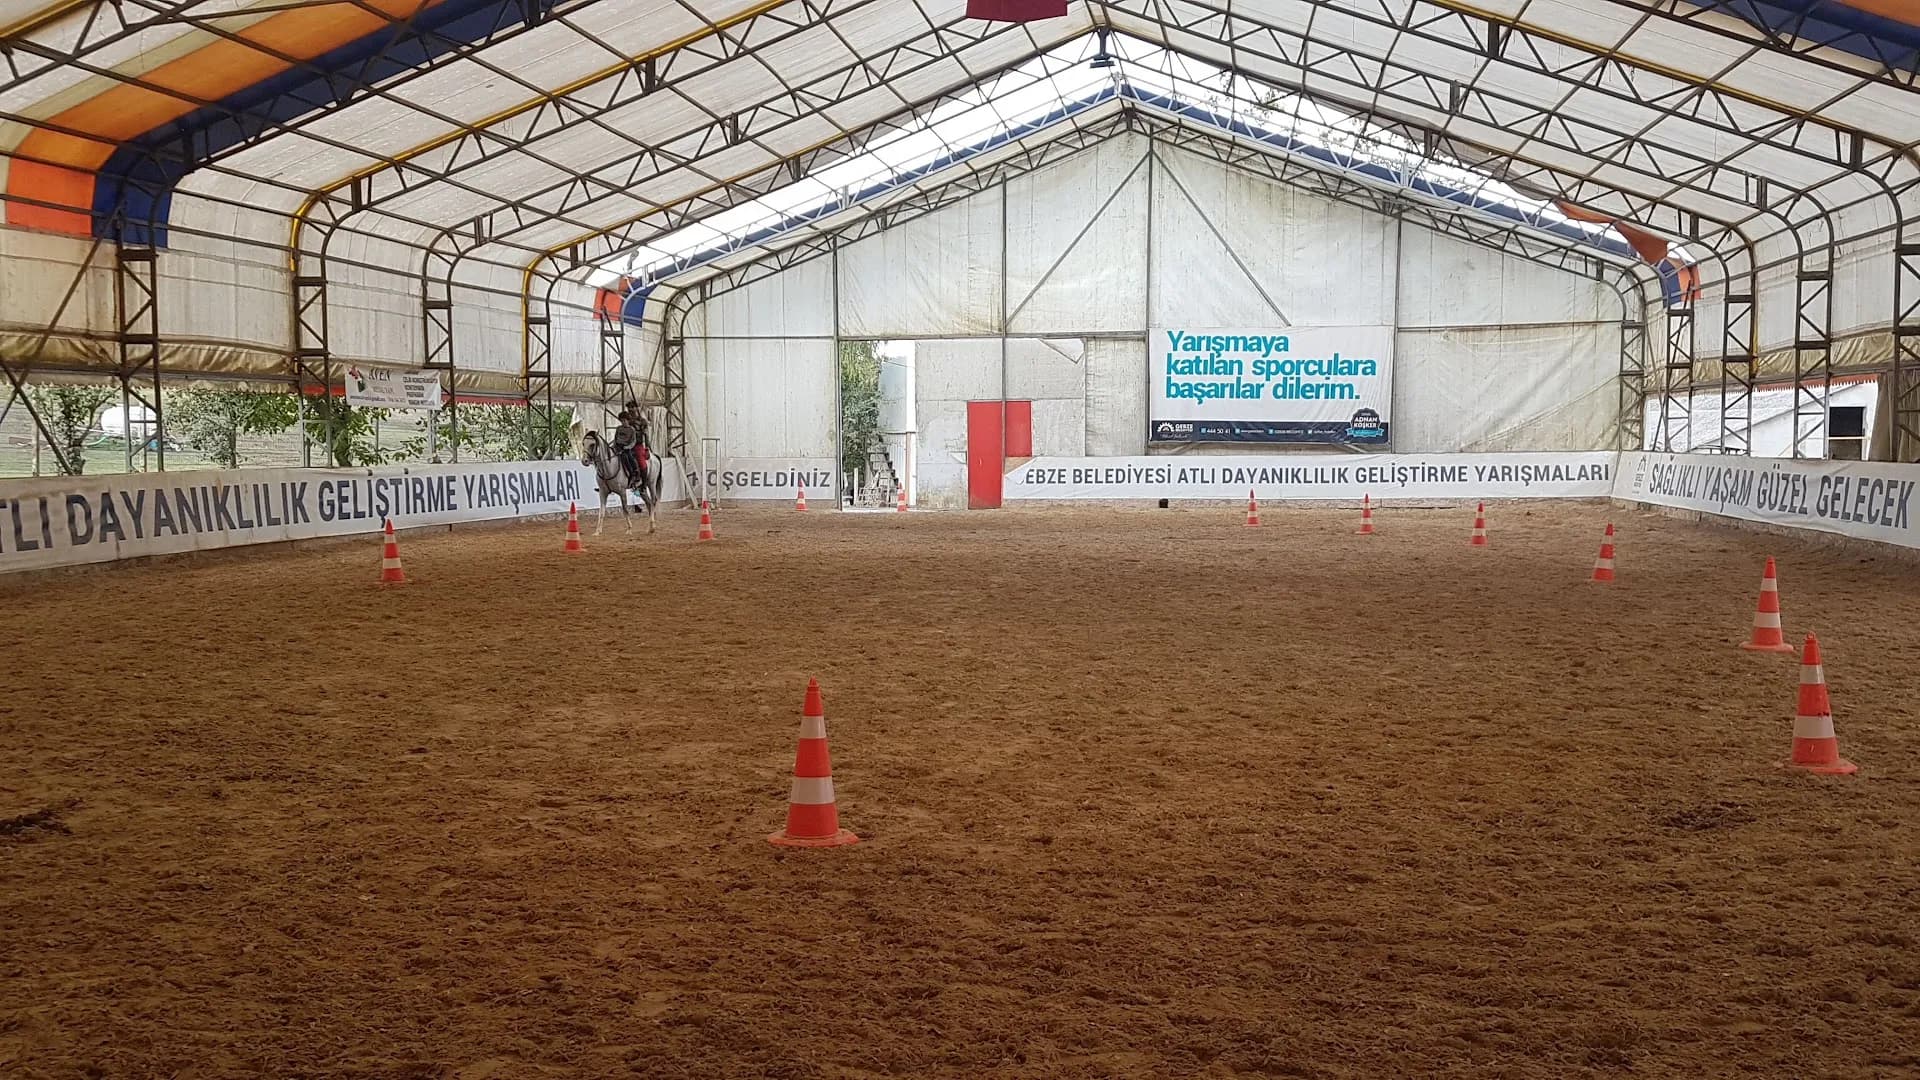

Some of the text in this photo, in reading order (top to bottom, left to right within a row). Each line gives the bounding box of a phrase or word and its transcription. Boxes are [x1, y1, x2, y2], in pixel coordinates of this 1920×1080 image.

[1167, 330, 1289, 358] Yarışmaya
[1166, 353, 1377, 381] katılan sporculara
[1165, 376, 1361, 405] başarılar dilerim.
[1017, 468, 1067, 485] EBZE
[1072, 463, 1172, 485] BELEDİYESİ
[1177, 467, 1216, 484] ATLI
[1221, 466, 1349, 485] DAYANIKLILIK
[1355, 462, 1469, 488] GELİŞTİRME
[1474, 463, 1610, 487] YARIŞMALARI
[1650, 454, 1702, 498] SAĞLIKLI
[1702, 465, 1754, 513] YAŞAM
[1757, 463, 1809, 514] GÜZEL
[1816, 475, 1914, 529] GELECEK
[66, 481, 311, 546] DAYANIKLILIK
[318, 467, 458, 529] GELİŞTİRME
[463, 470, 581, 515] YARIŞMALARI
